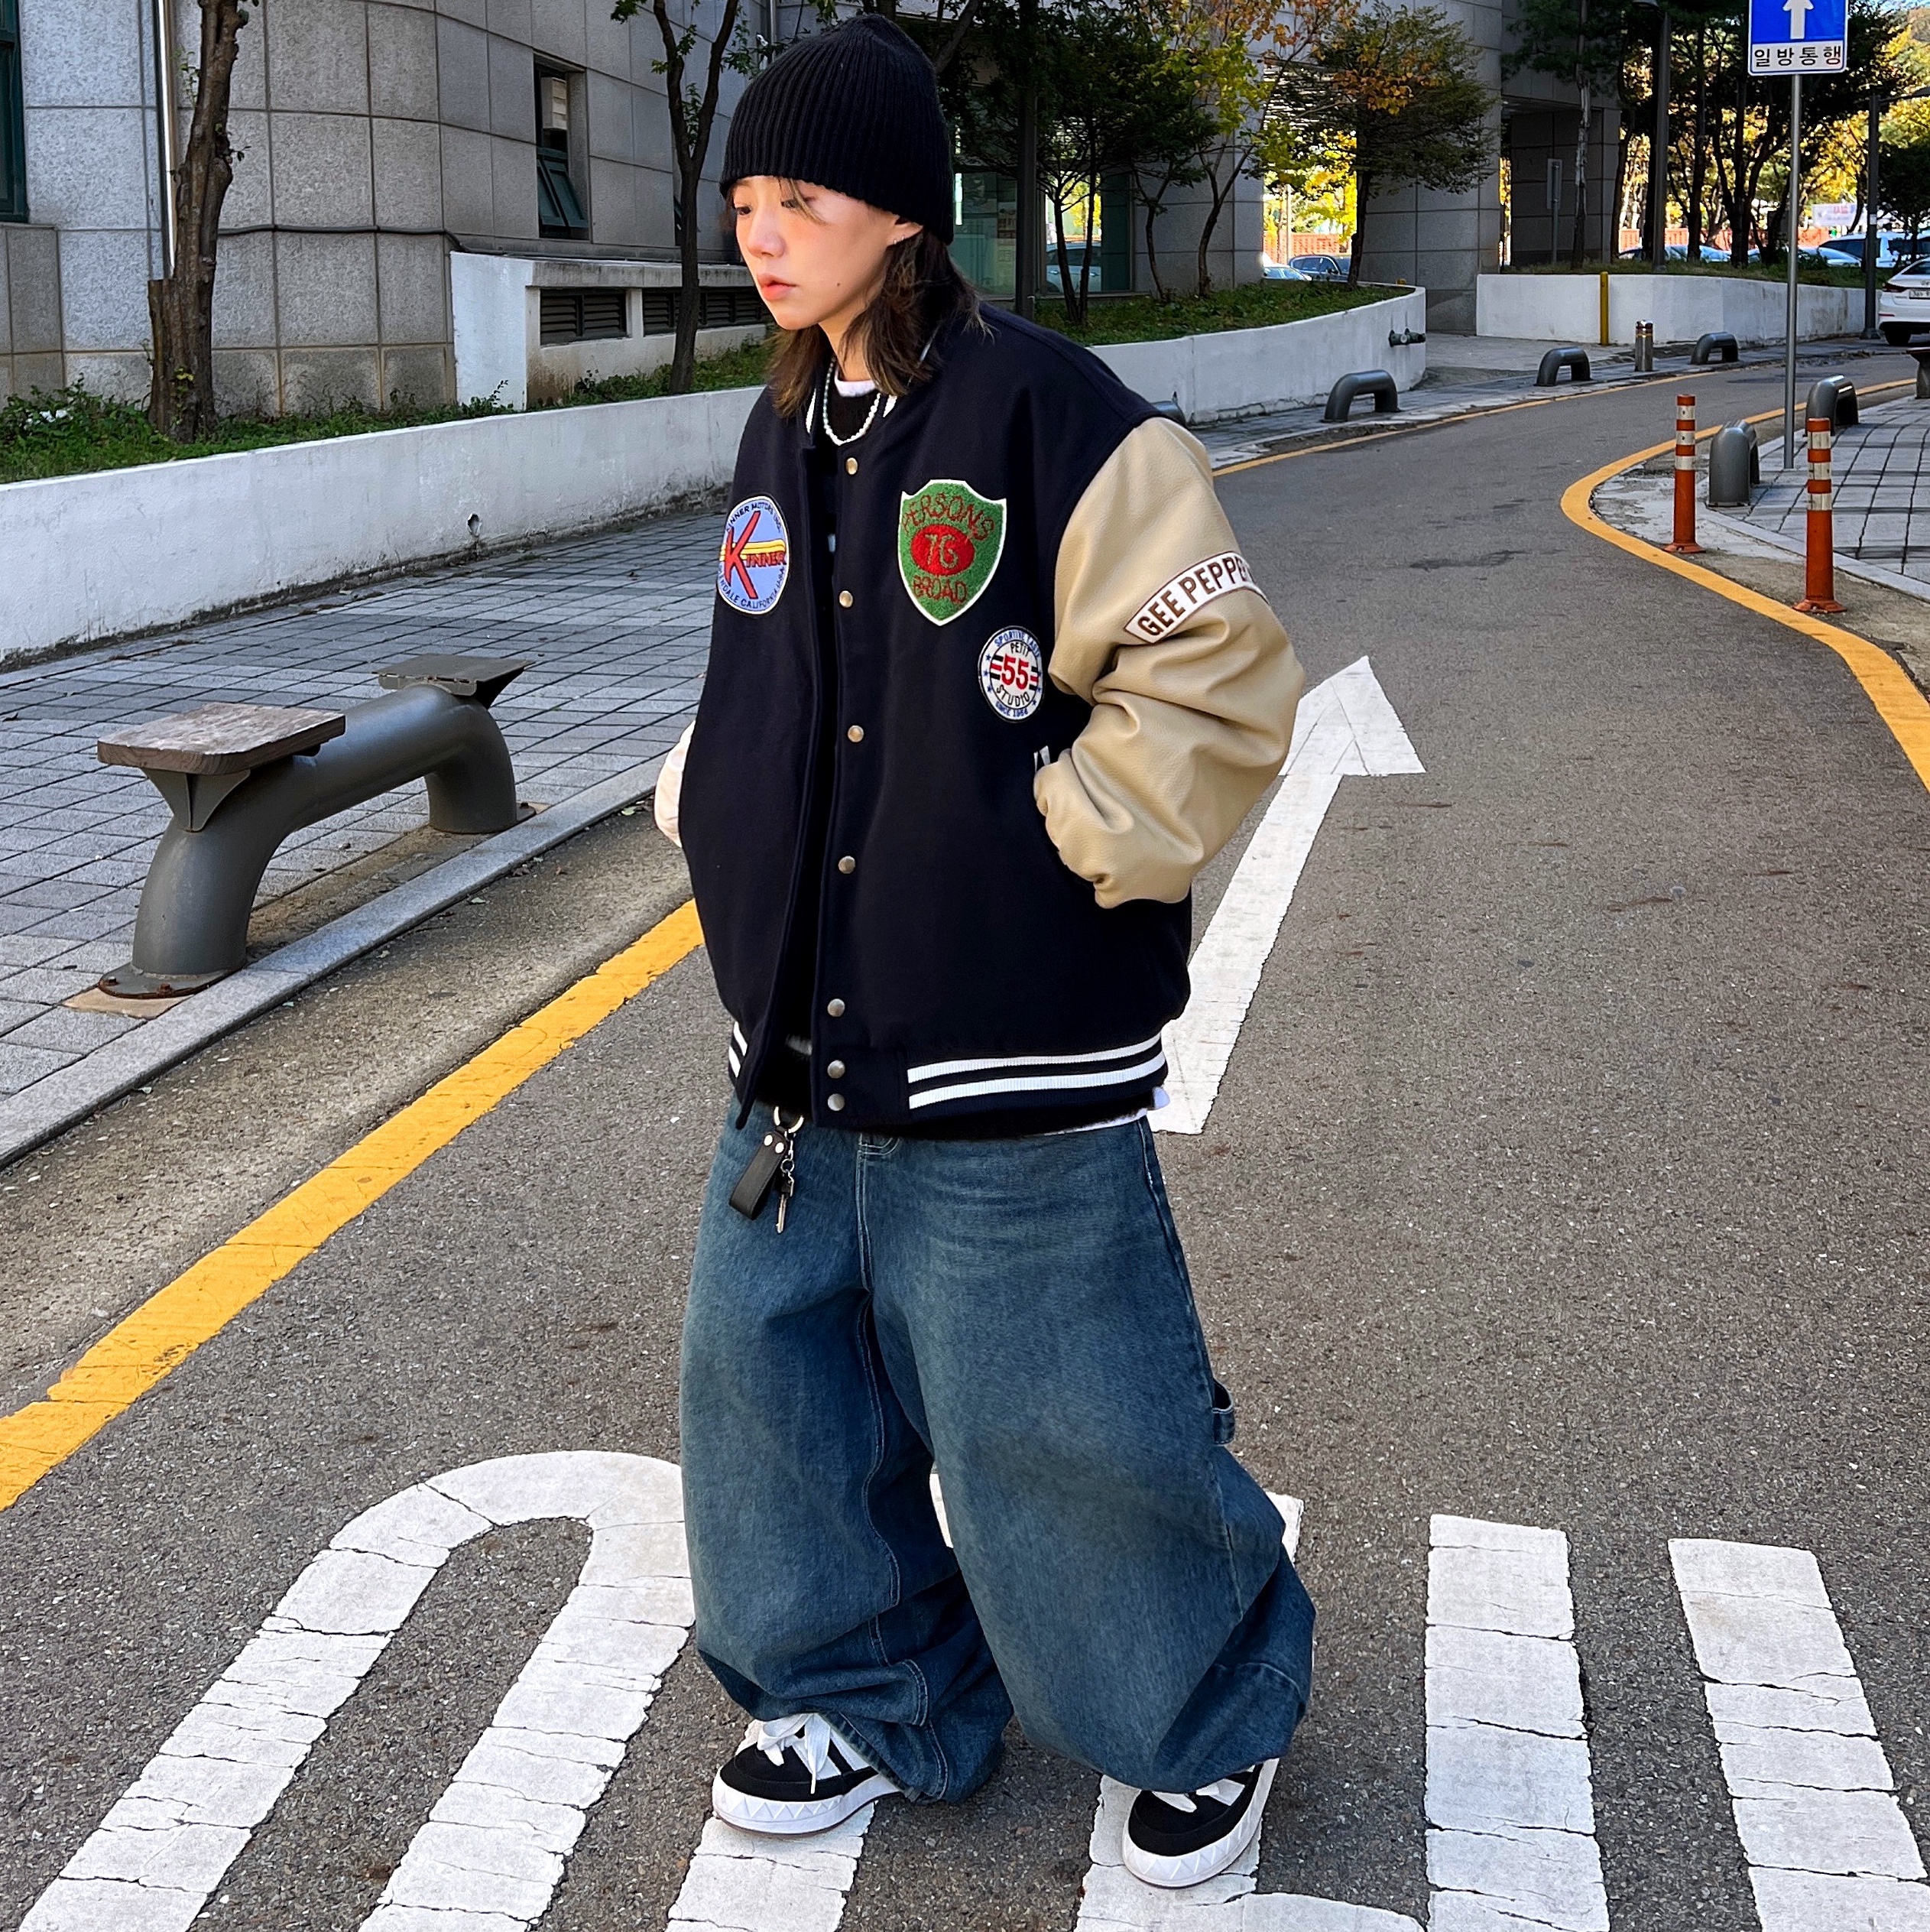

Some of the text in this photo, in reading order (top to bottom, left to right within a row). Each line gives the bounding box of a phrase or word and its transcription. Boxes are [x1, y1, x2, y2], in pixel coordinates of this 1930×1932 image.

[1754, 46, 1841, 67] 일방통행
[913, 576, 968, 604] BROAD
[1137, 557, 1247, 635] GEE PEPPE
[1001, 654, 1029, 690] 55
[997, 684, 1030, 706] STUDIO
